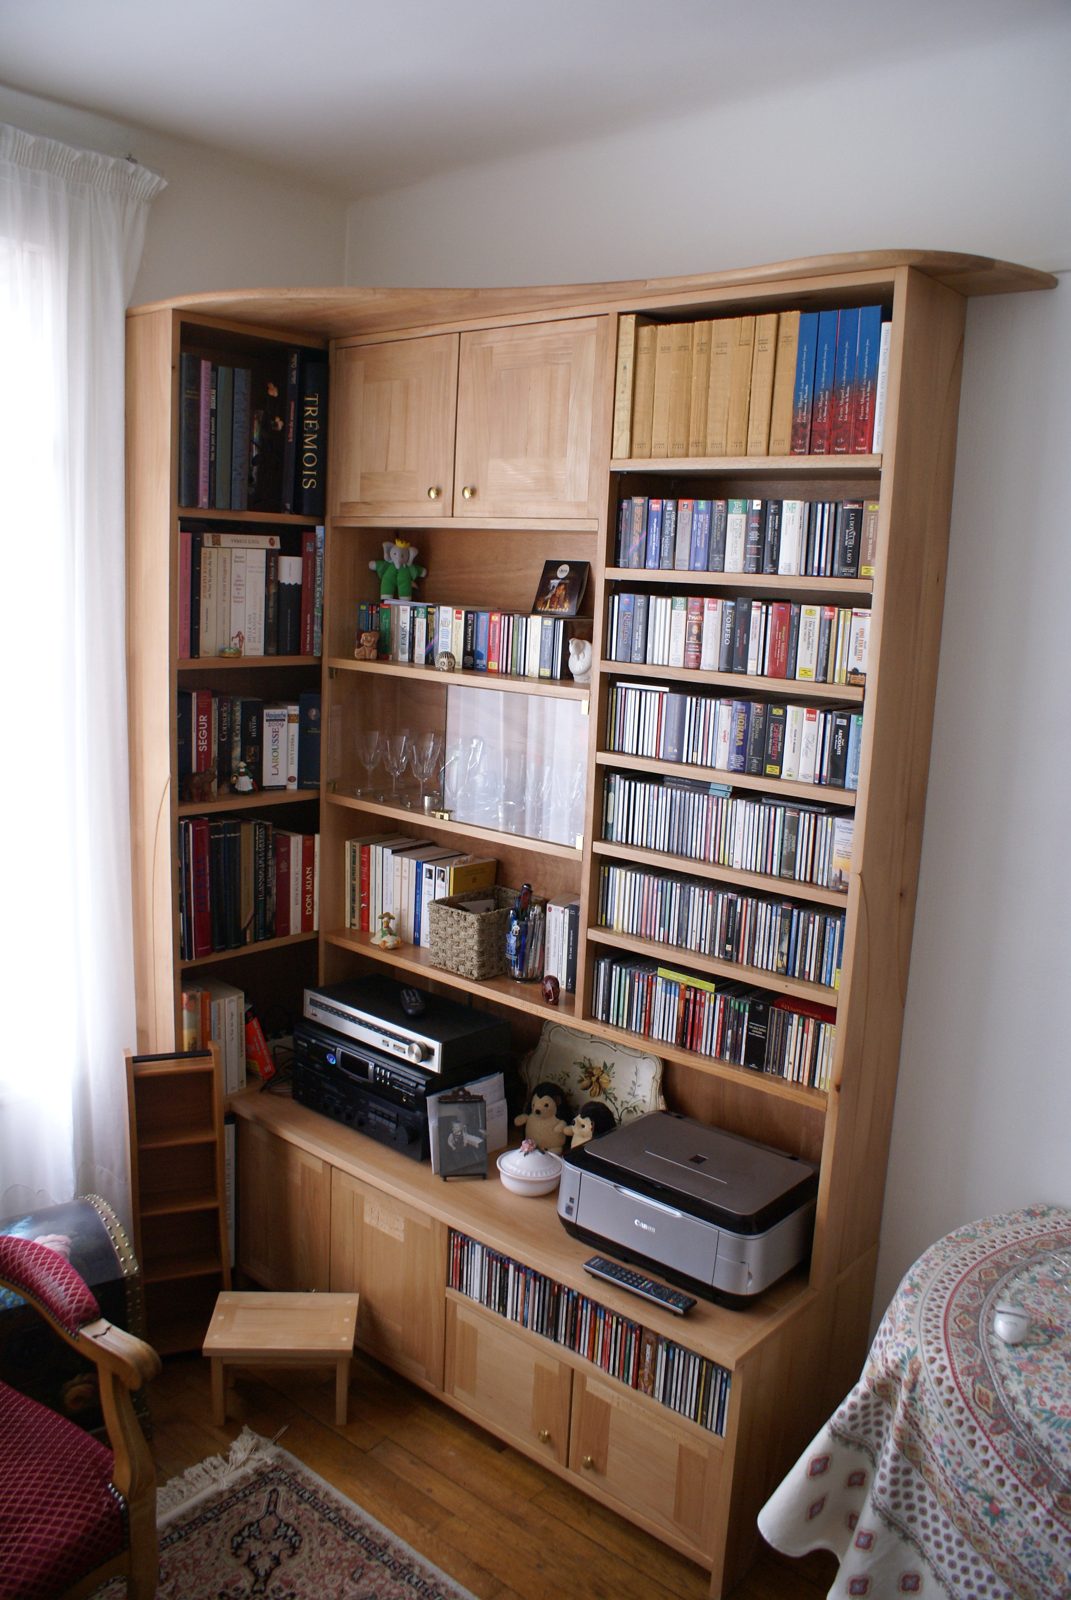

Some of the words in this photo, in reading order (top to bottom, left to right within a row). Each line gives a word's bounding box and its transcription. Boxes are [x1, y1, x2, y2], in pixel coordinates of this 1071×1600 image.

[301, 392, 320, 491] TRÉMOIS
[724, 609, 732, 645] L'ORFEO
[198, 715, 208, 752] SEGUR
[736, 712, 745, 746] NORMA
[271, 728, 280, 776] LAROUSSE
[634, 1218, 656, 1234] Canon
